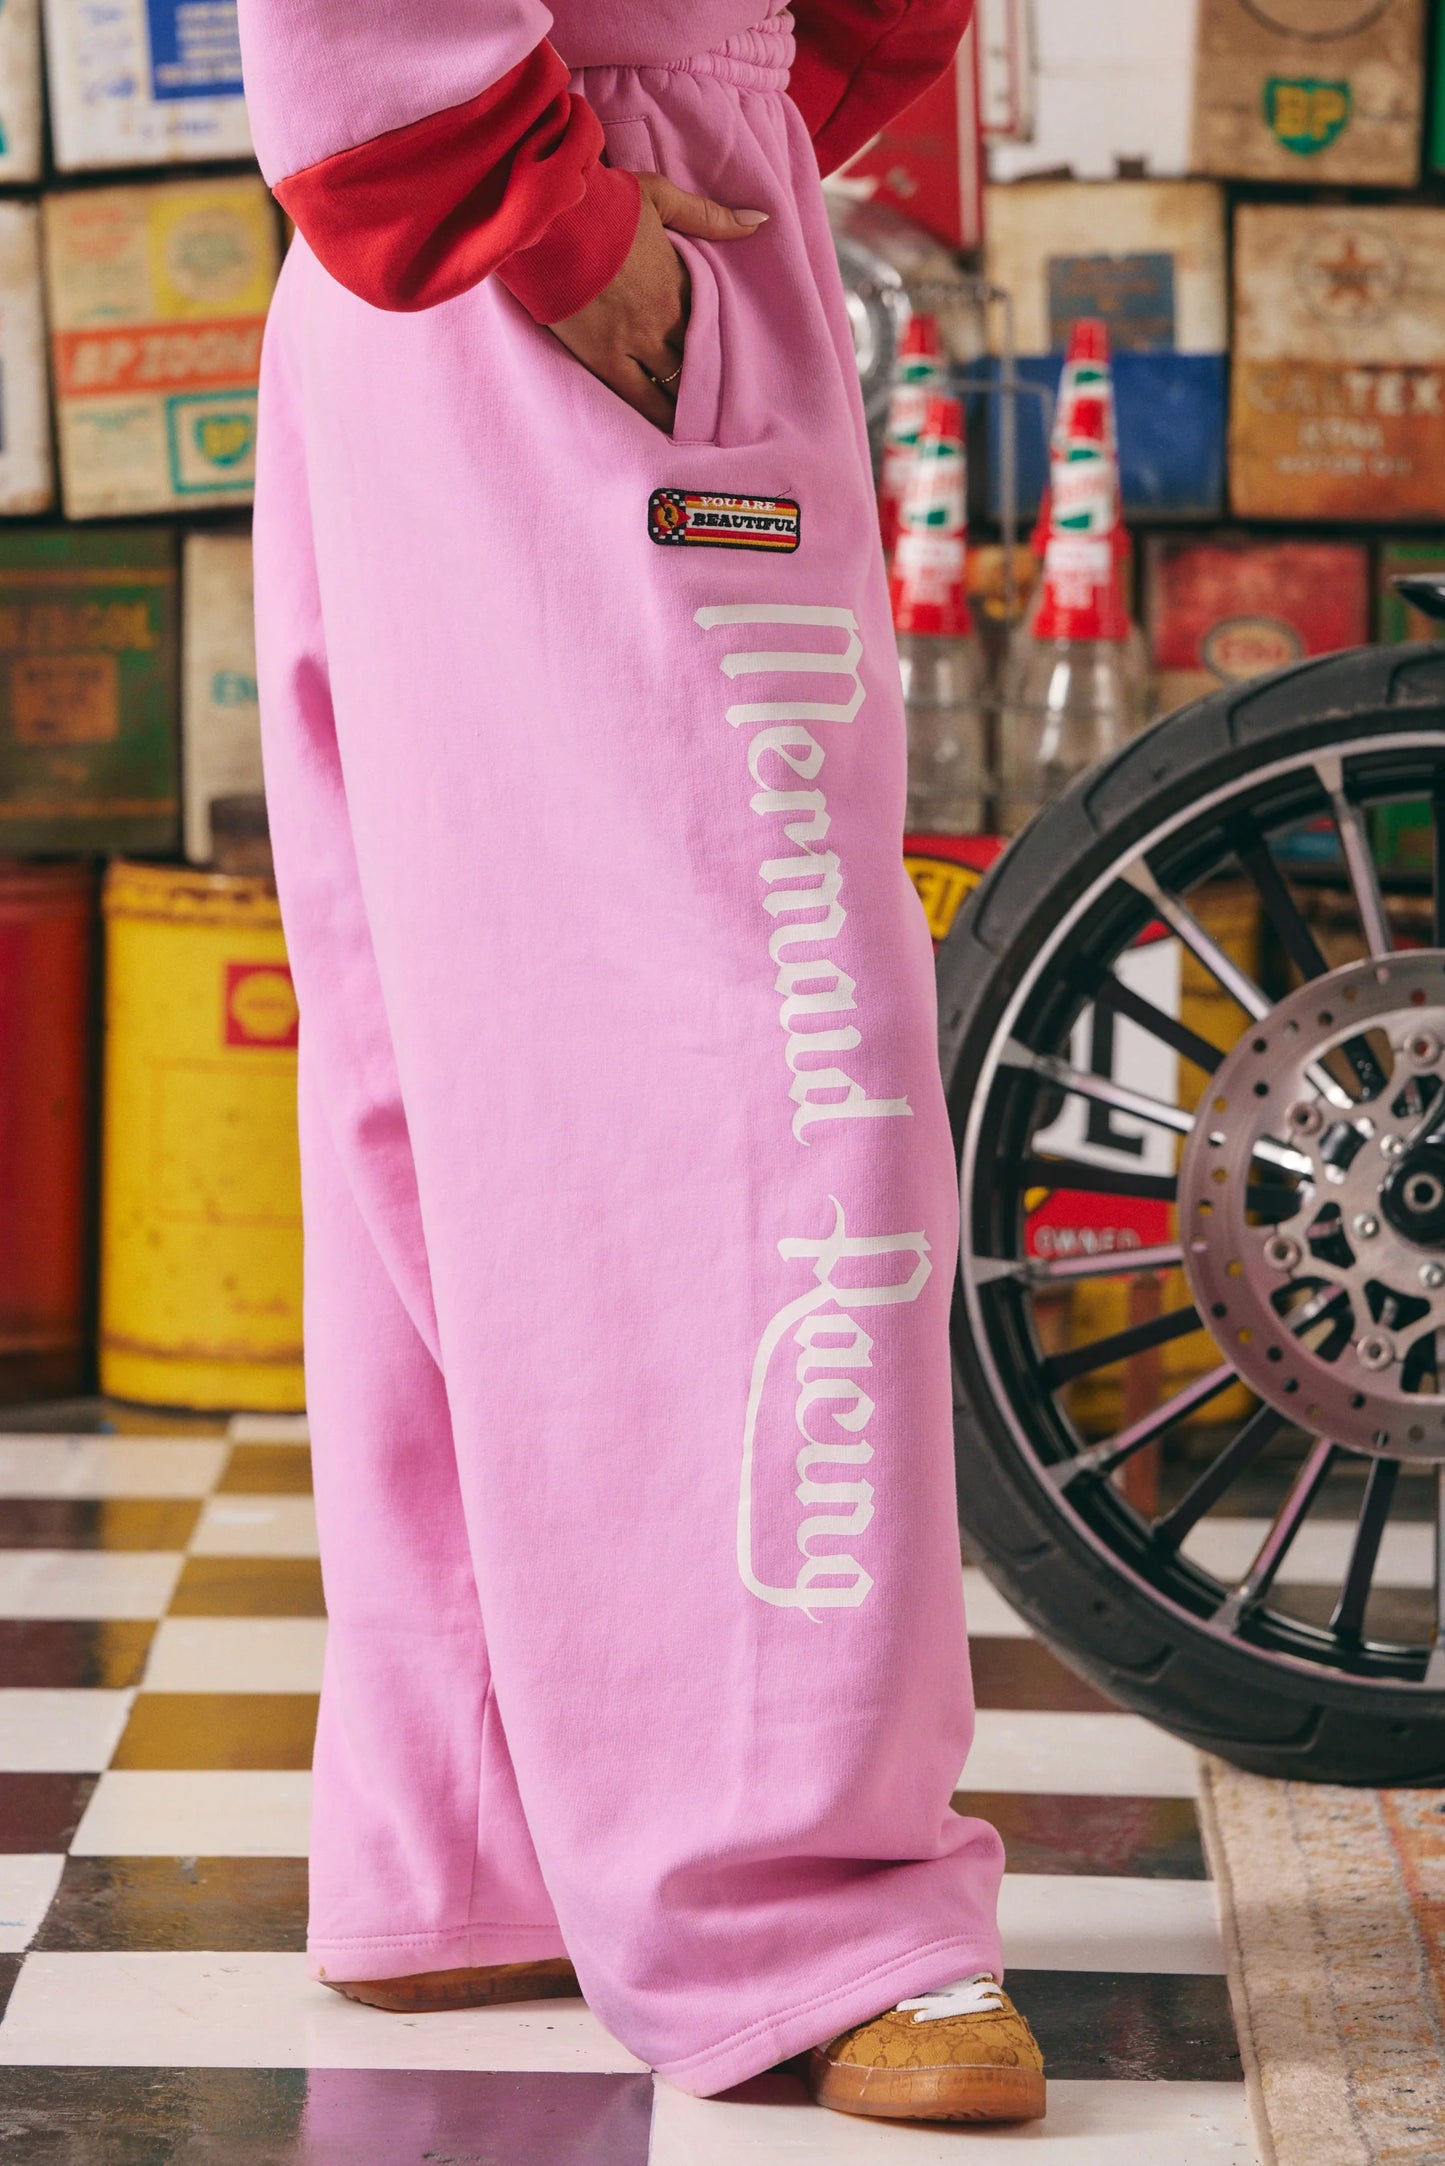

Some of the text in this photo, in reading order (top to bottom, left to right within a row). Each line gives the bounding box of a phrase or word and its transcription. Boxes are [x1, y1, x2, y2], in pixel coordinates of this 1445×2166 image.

[1276, 86, 1345, 139] BP
[1248, 371, 1442, 417] CALTEX
[692, 513, 796, 533] BEAUTIFUL
[700, 497, 777, 512] YOU ARE
[693, 603, 933, 1624] Mermaid Racing
